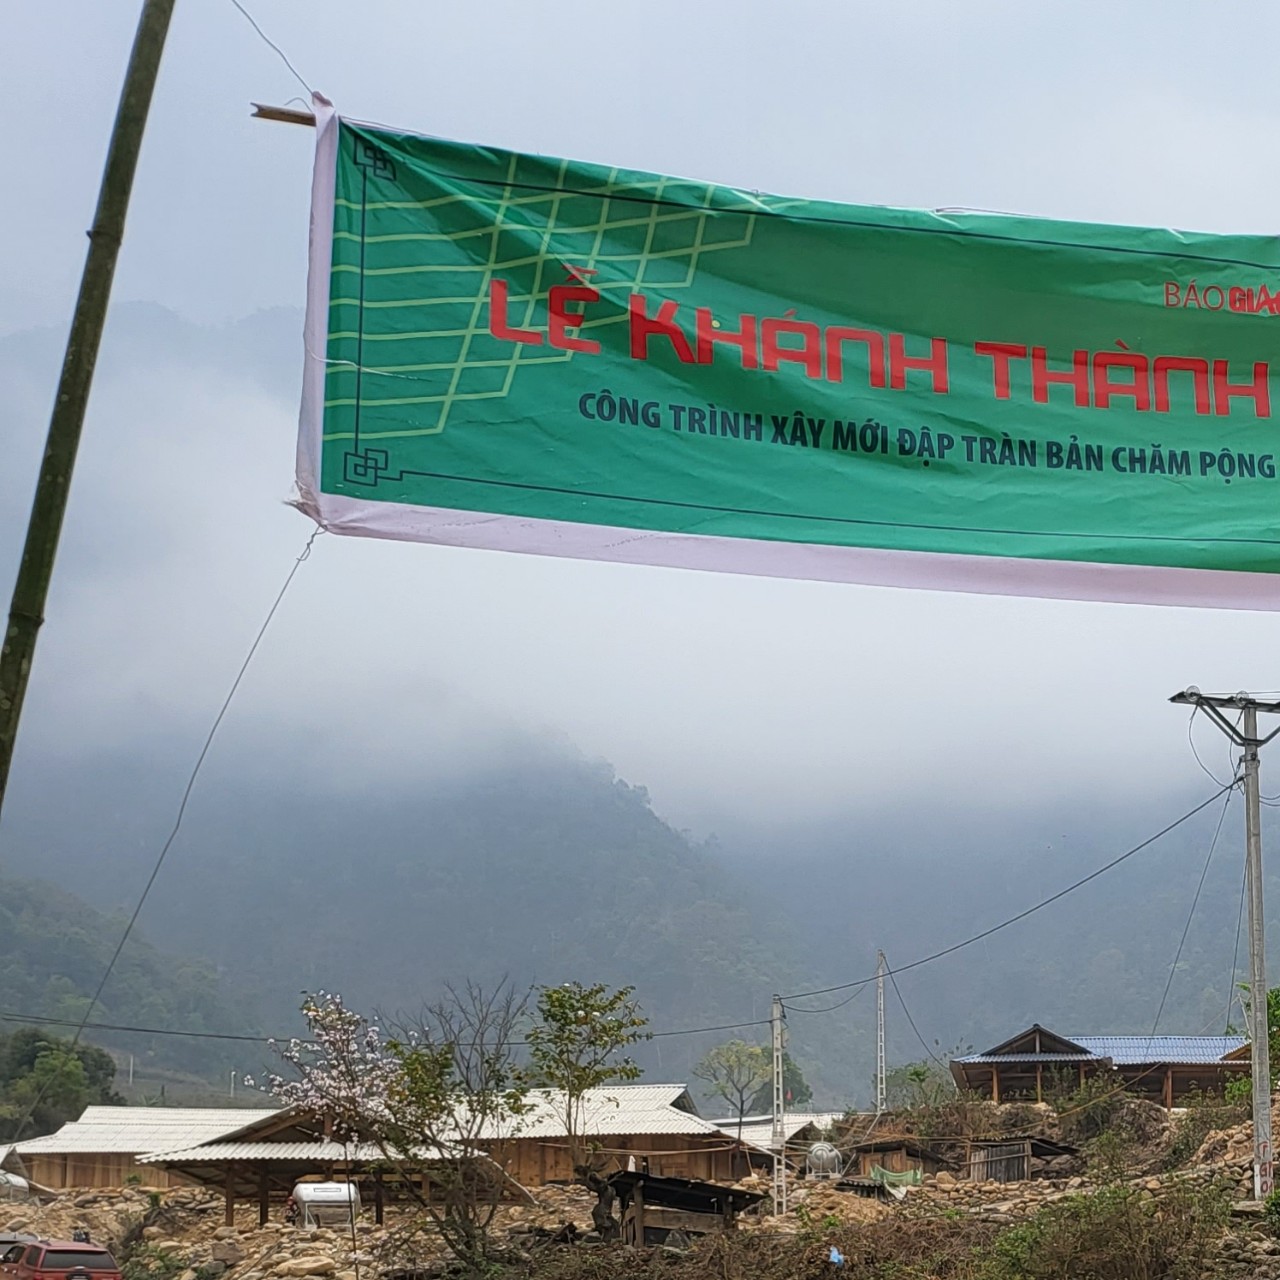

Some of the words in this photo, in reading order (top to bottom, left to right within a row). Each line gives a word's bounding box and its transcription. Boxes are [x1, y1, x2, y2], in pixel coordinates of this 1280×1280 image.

[490, 264, 600, 354] LỄ
[630, 294, 949, 393] KHÁNH
[974, 337, 1271, 418] THÀNH
[1164, 279, 1224, 311] BÁO
[578, 389, 661, 429] CÔNG
[669, 401, 763, 442] TRÌNH
[771, 410, 827, 448] XÂY
[832, 419, 888, 454] MỚI
[896, 426, 954, 467] ĐẬP
[961, 432, 1037, 468] TRÀN
[1046, 435, 1104, 471] BẢN
[1111, 443, 1191, 476] CHĂM
[1200, 448, 1275, 485] PỘNG
